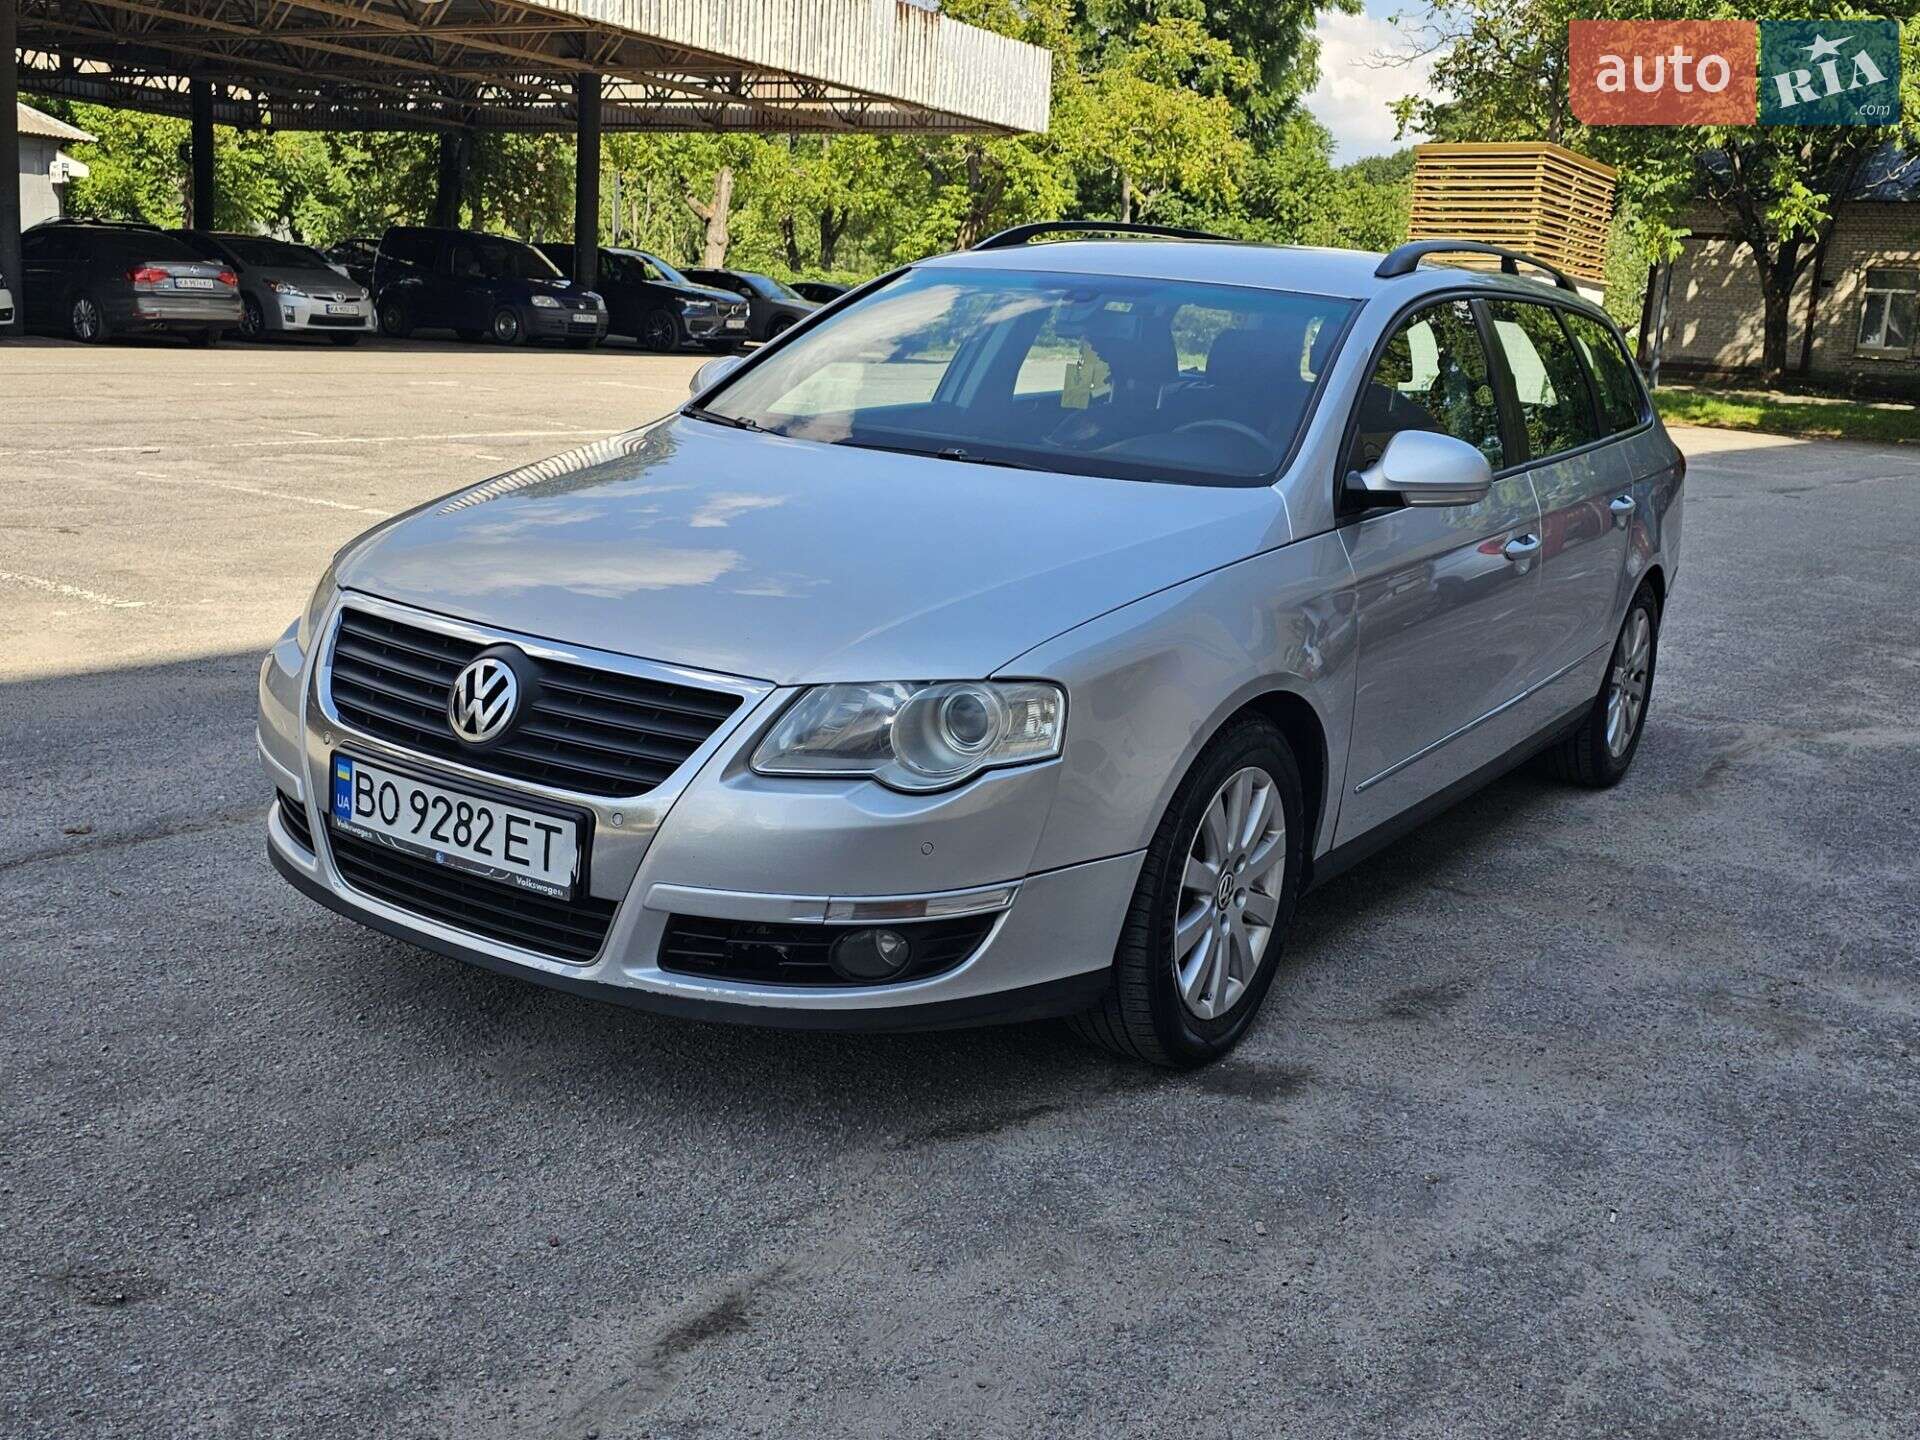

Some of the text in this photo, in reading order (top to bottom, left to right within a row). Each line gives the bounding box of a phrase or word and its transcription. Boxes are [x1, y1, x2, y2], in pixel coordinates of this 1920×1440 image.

[337, 793, 350, 811] UA
[355, 770, 563, 873] BO 9282 ET
